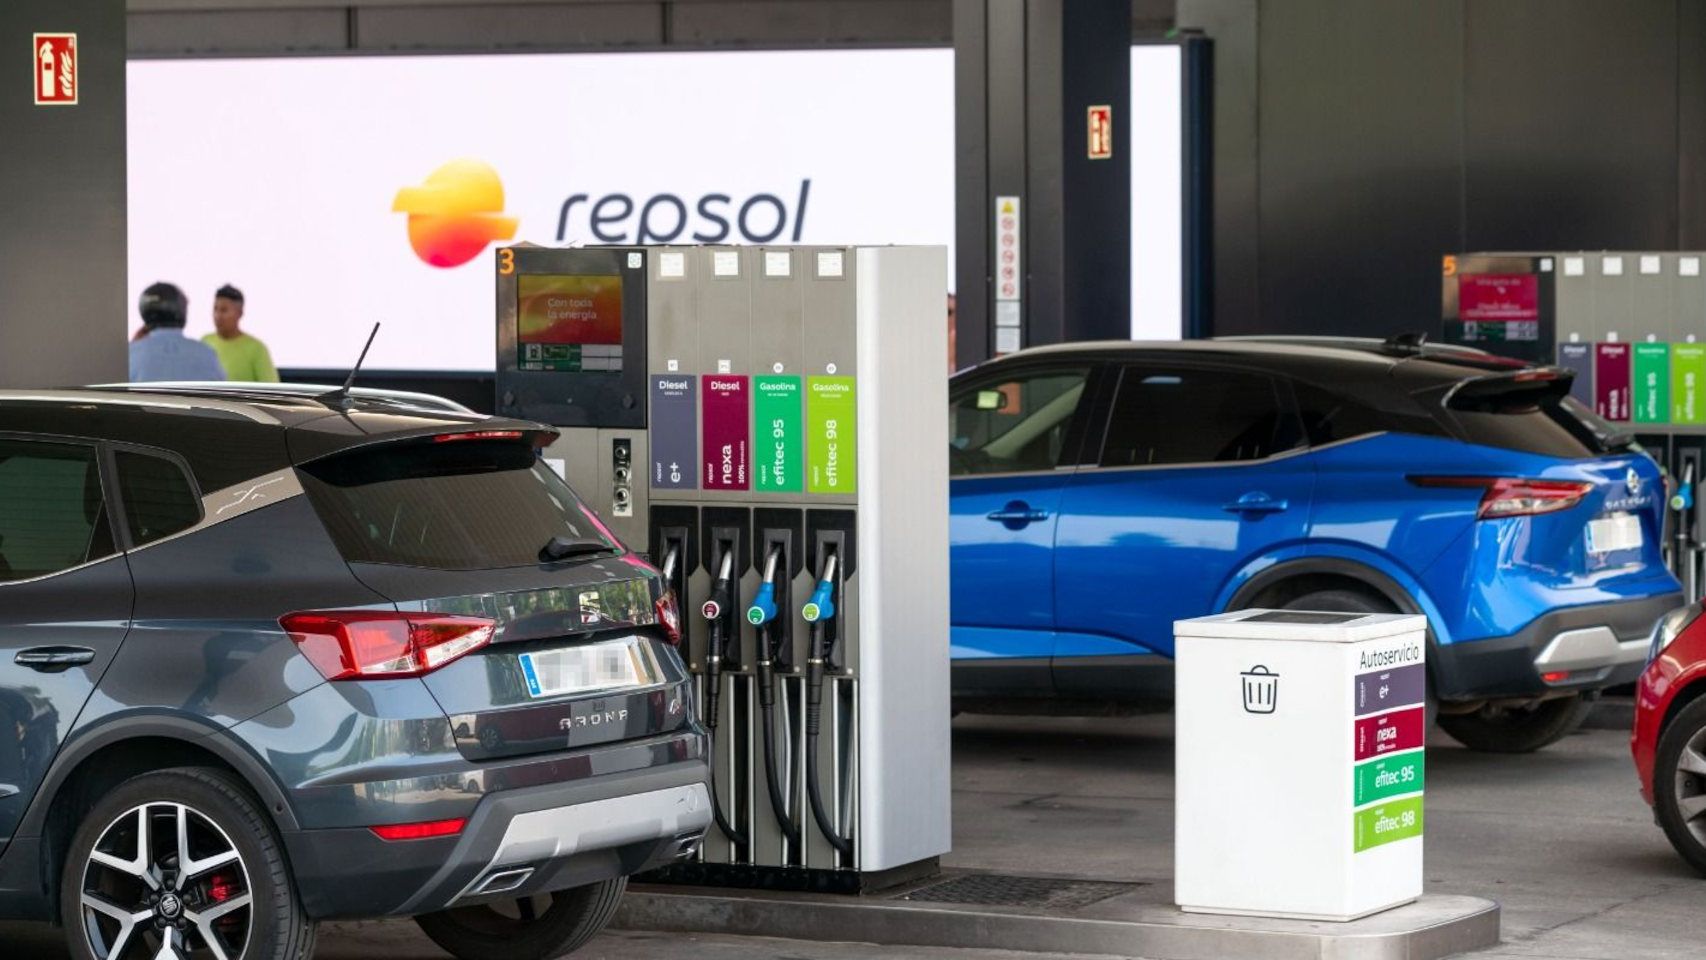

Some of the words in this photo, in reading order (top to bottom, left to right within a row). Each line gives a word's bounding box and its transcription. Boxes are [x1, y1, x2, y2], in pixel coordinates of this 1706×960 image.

[556, 178, 811, 245] repsol
[500, 249, 514, 274] 3
[1443, 256, 1456, 275] 5
[659, 381, 688, 390] Diesel
[711, 381, 740, 390] Diesel
[759, 382, 796, 391] Gasolina
[813, 383, 850, 392] Gasolina
[773, 419, 785, 438] 95
[826, 419, 837, 439] 98
[670, 462, 681, 483] e+
[722, 444, 732, 484] nexa
[773, 442, 785, 485] efitec
[826, 443, 837, 487] efitec
[1360, 643, 1419, 668] Autoservicio
[1379, 684, 1390, 699] e+
[1377, 726, 1397, 742] nexa
[1375, 770, 1400, 788] efitec
[1401, 764, 1415, 783] 95
[1375, 815, 1400, 834] efitec
[1401, 810, 1416, 829] 98
